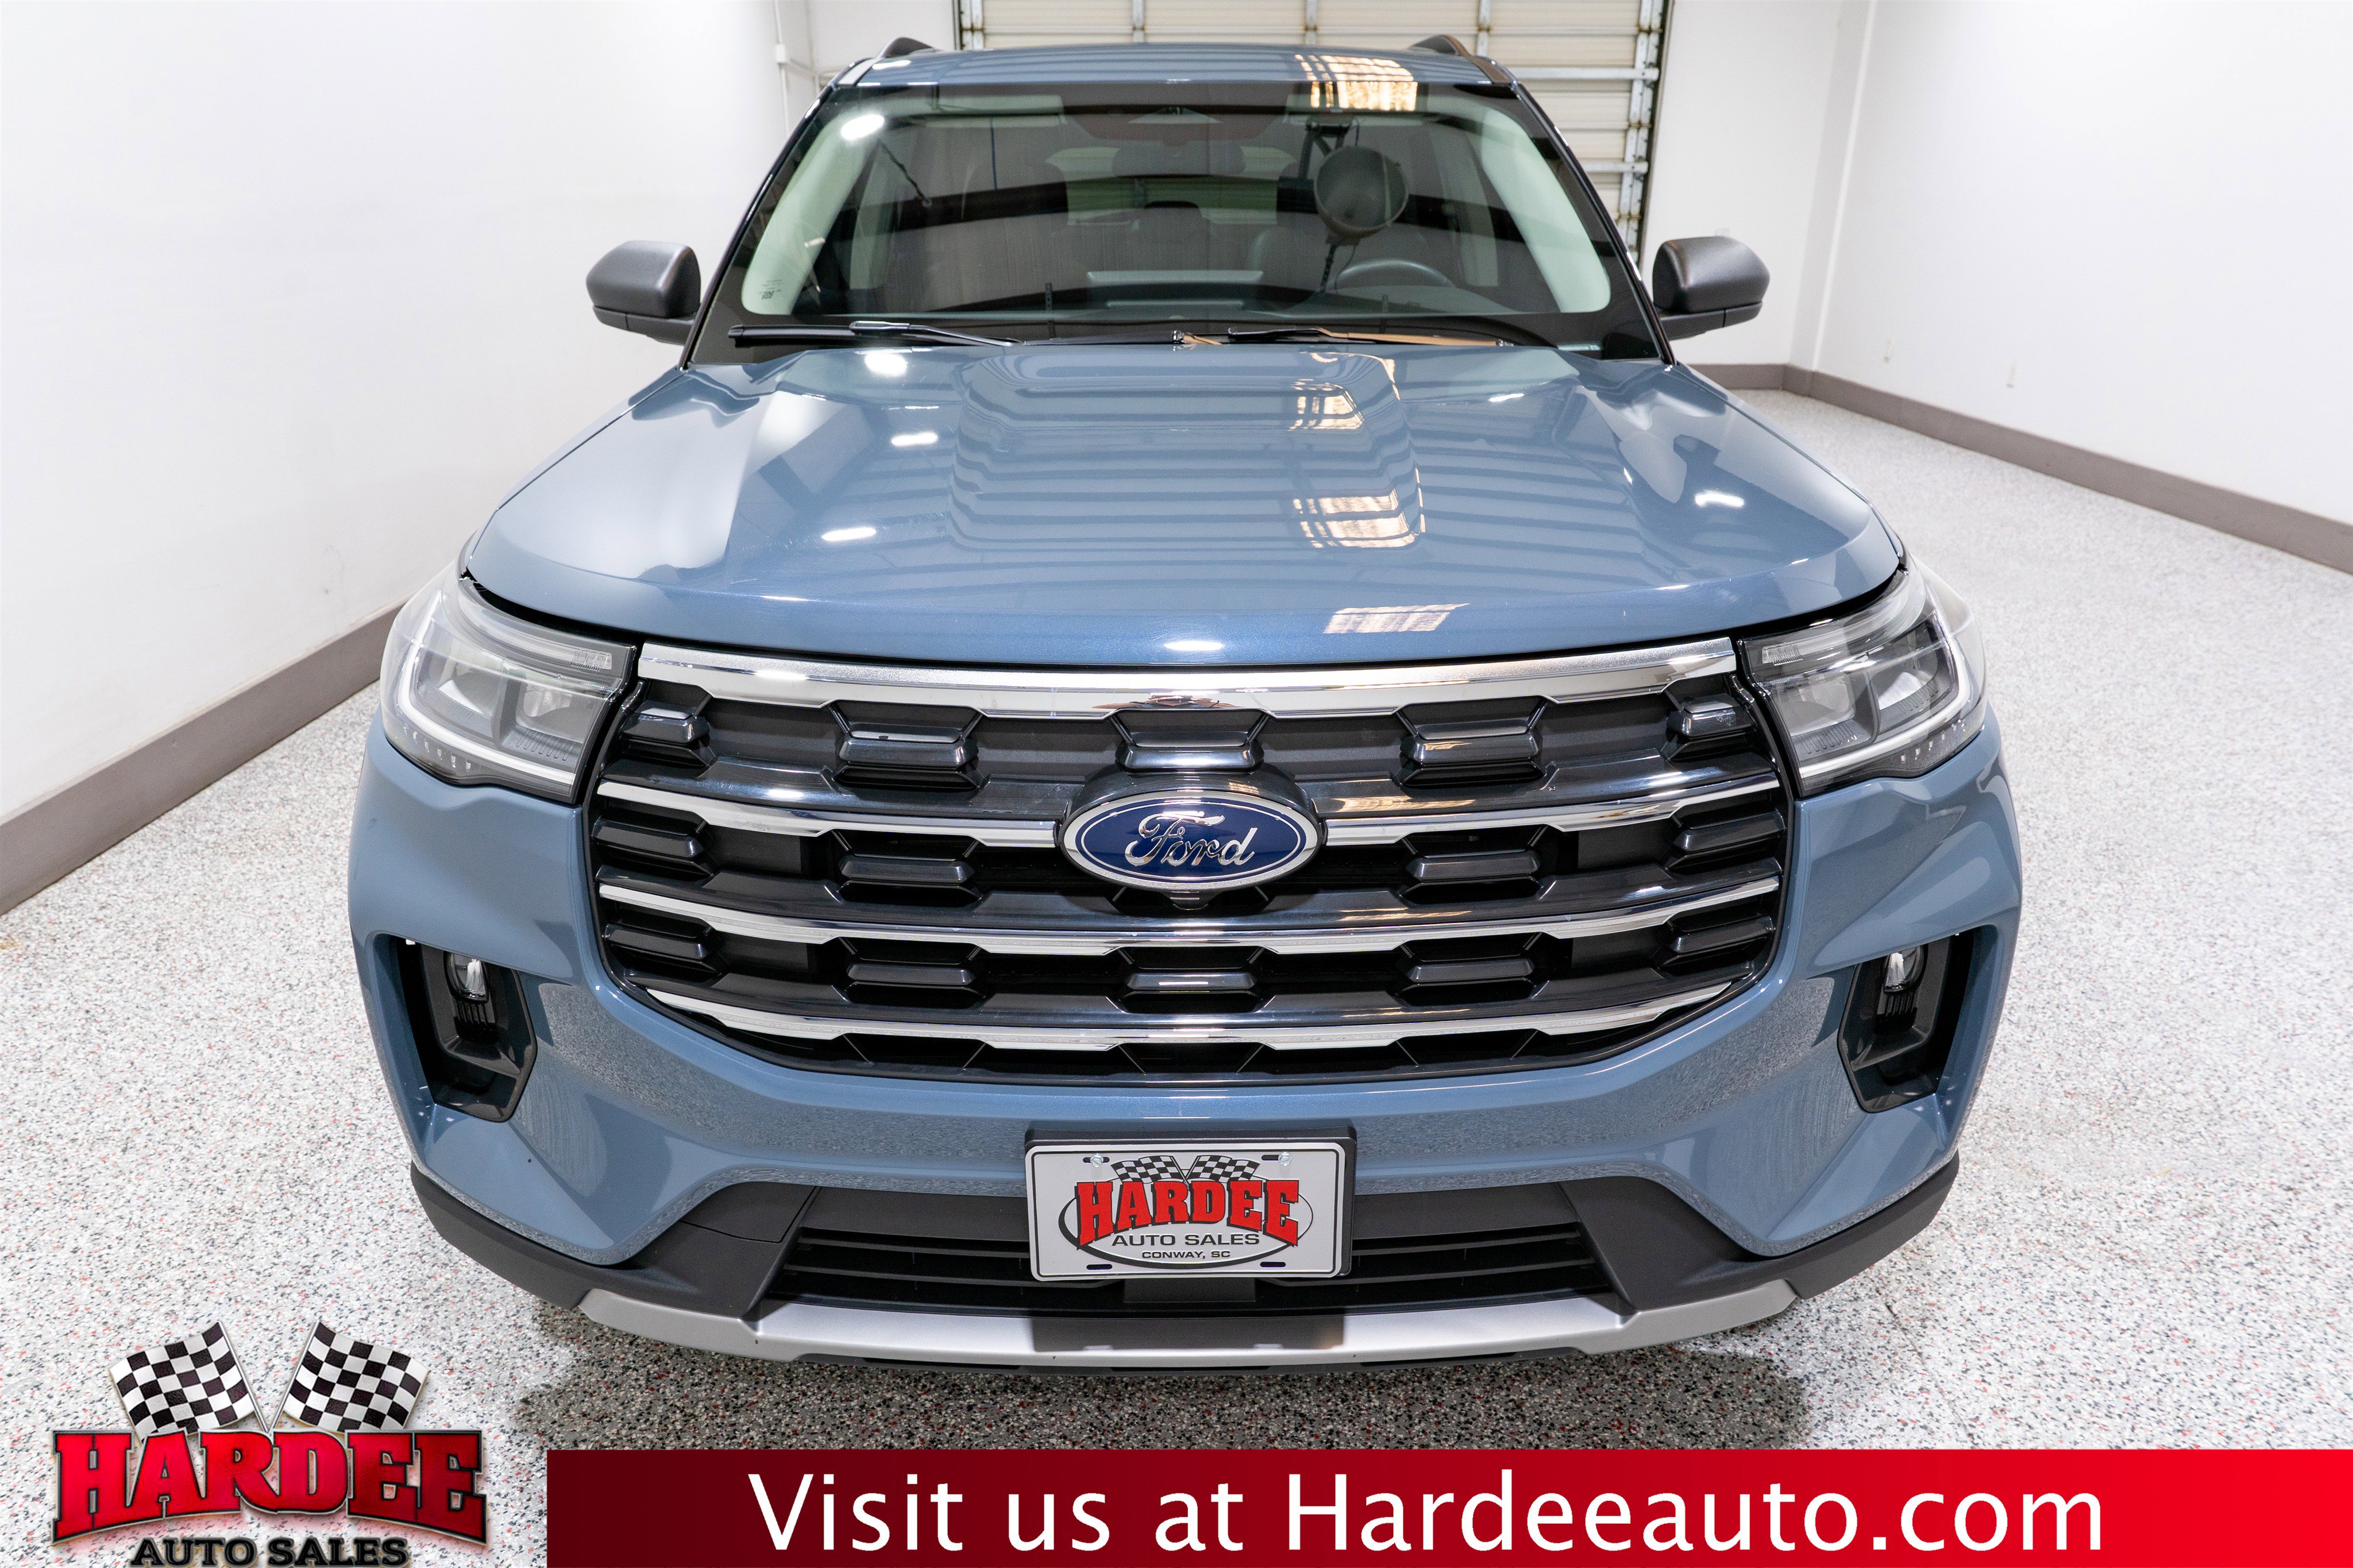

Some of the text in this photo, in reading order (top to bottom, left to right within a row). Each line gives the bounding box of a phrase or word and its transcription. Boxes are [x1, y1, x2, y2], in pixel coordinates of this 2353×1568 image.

[1124, 812, 1258, 866] Ford
[1076, 1180, 1299, 1248] HARDEE
[1112, 1233, 1260, 1246] AUTO SALES
[1141, 1251, 1206, 1259] CONWAY,
